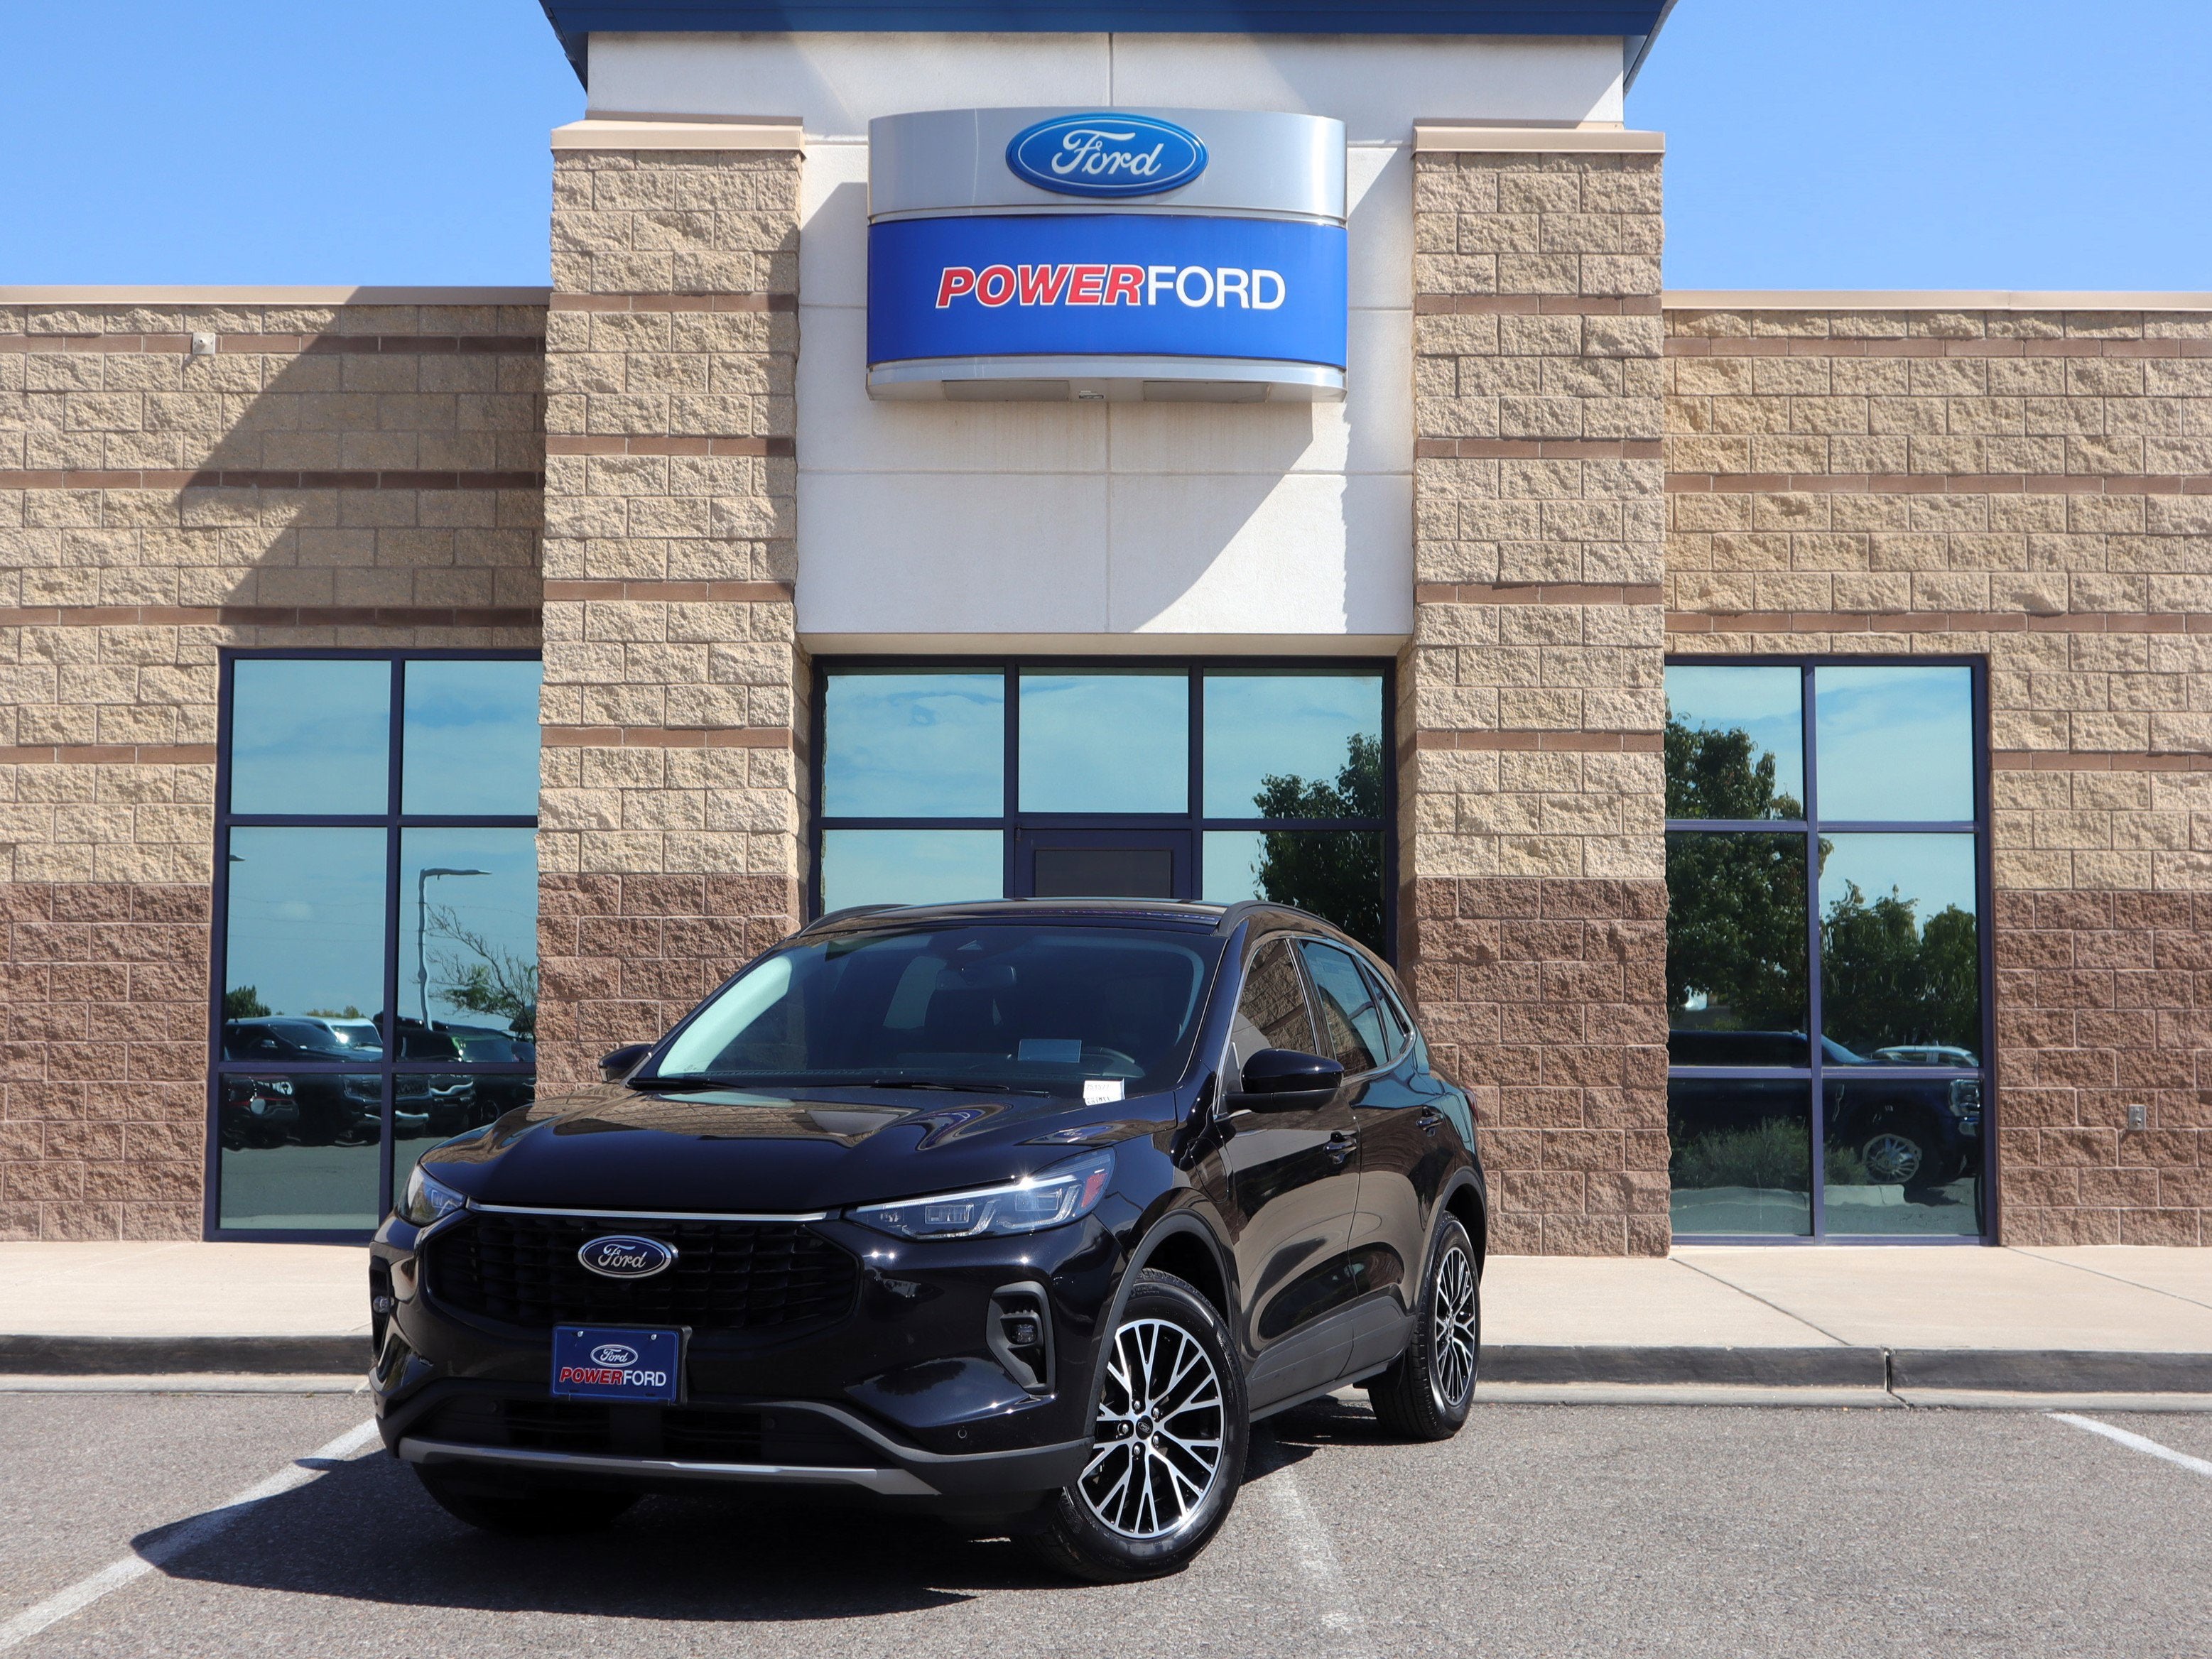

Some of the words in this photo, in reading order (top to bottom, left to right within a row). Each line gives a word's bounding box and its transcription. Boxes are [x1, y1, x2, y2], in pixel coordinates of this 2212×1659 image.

[1051, 129, 1163, 175] Ford
[597, 1244, 648, 1268] Ford
[600, 1349, 628, 1363] Ford
